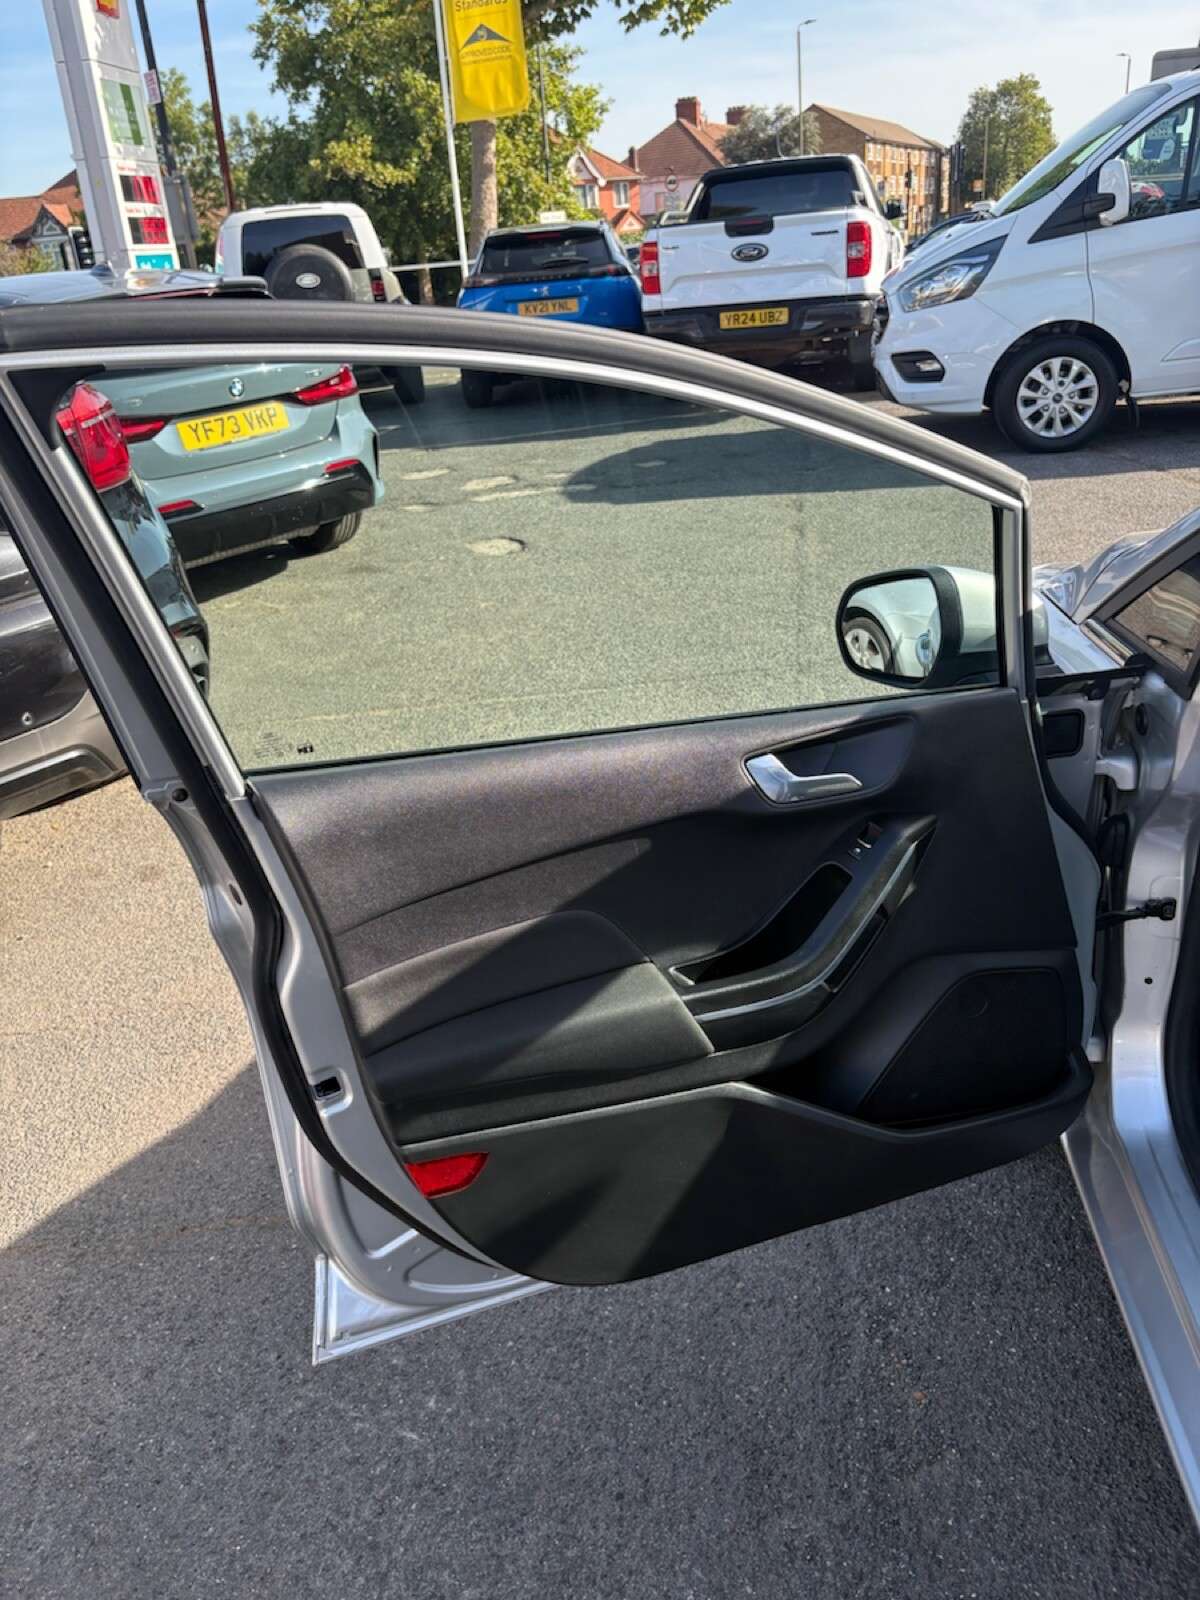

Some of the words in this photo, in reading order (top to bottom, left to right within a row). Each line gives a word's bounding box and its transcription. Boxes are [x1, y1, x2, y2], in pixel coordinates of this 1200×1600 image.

[524, 301, 547, 314] KV21
[549, 300, 572, 312] YNL
[724, 313, 757, 326] YR24
[759, 310, 784, 323] UBZ
[188, 415, 241, 443] YF73
[242, 406, 278, 431] VKP
